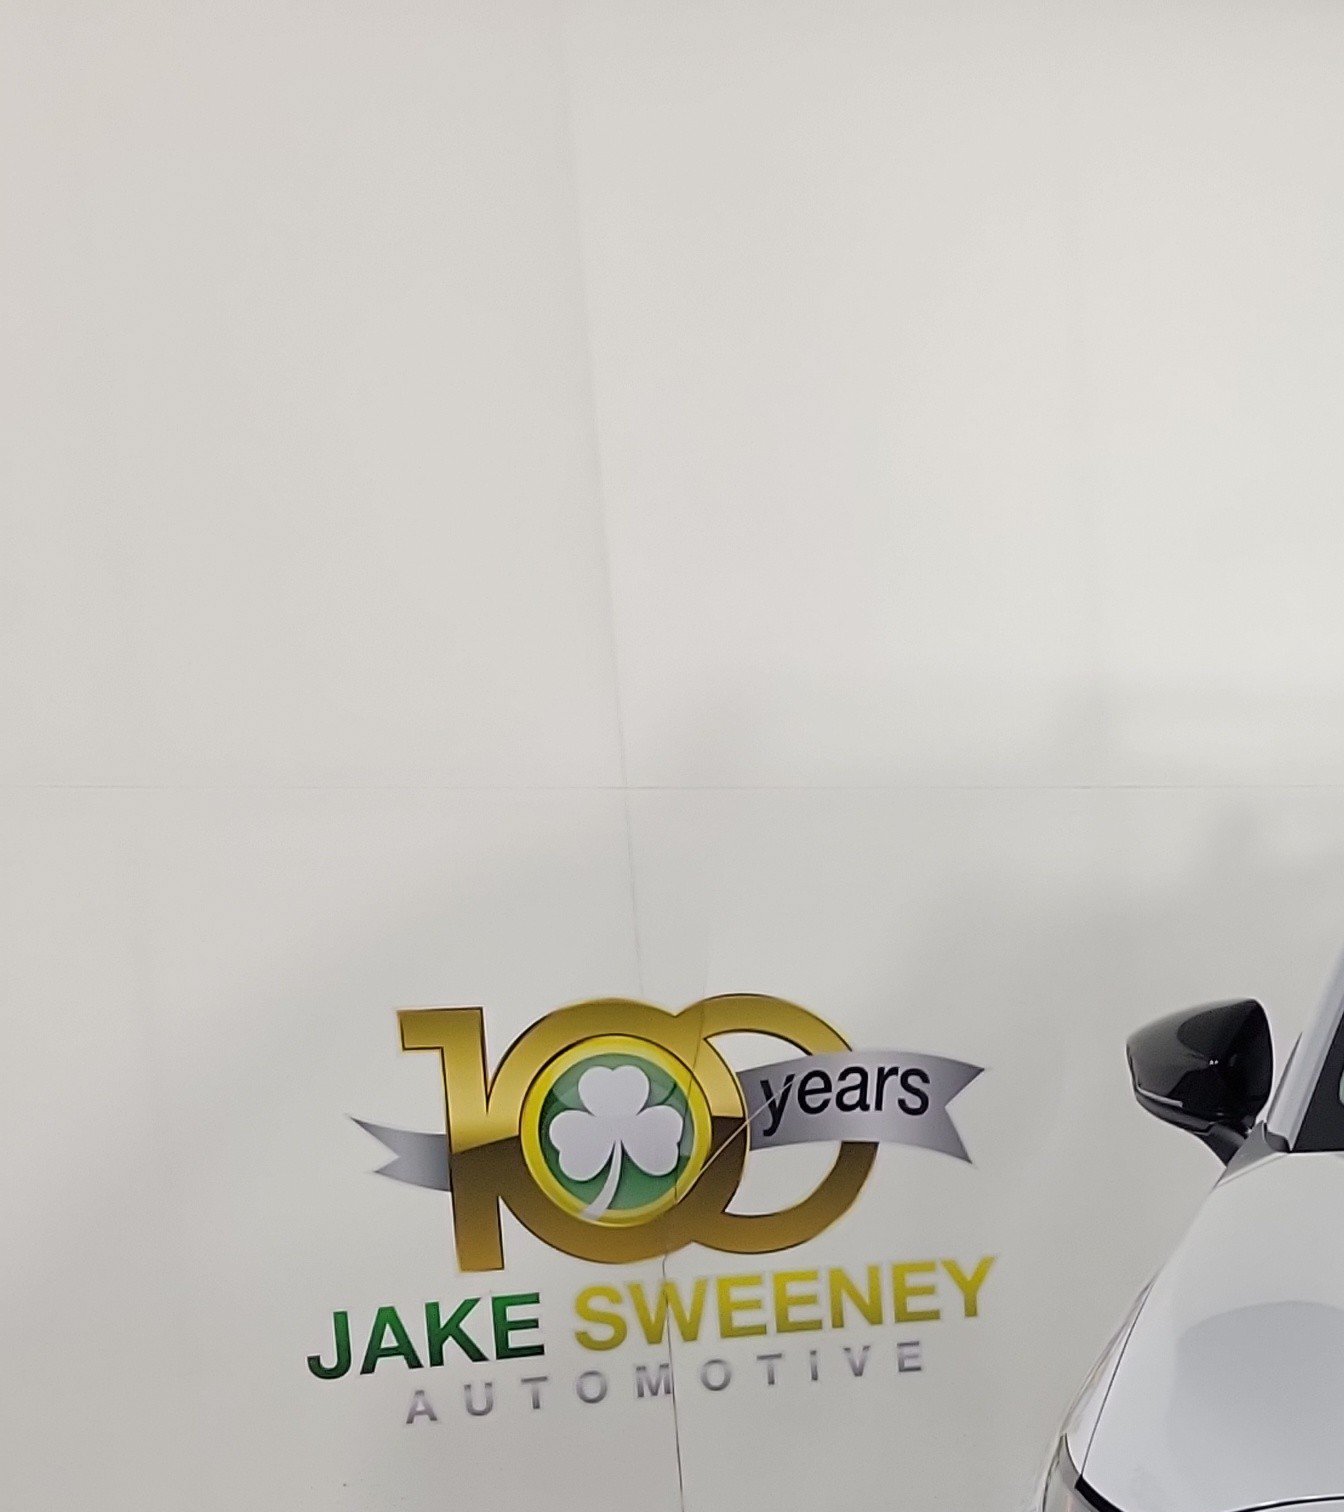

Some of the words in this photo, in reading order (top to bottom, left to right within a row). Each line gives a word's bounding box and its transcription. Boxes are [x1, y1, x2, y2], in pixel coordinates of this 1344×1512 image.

[398, 993, 879, 1273] 100
[760, 1064, 930, 1136] years
[307, 1292, 545, 1380] JAKE
[574, 1256, 996, 1351] SWEENEY
[406, 1341, 923, 1424] AUTOMOTIVE
